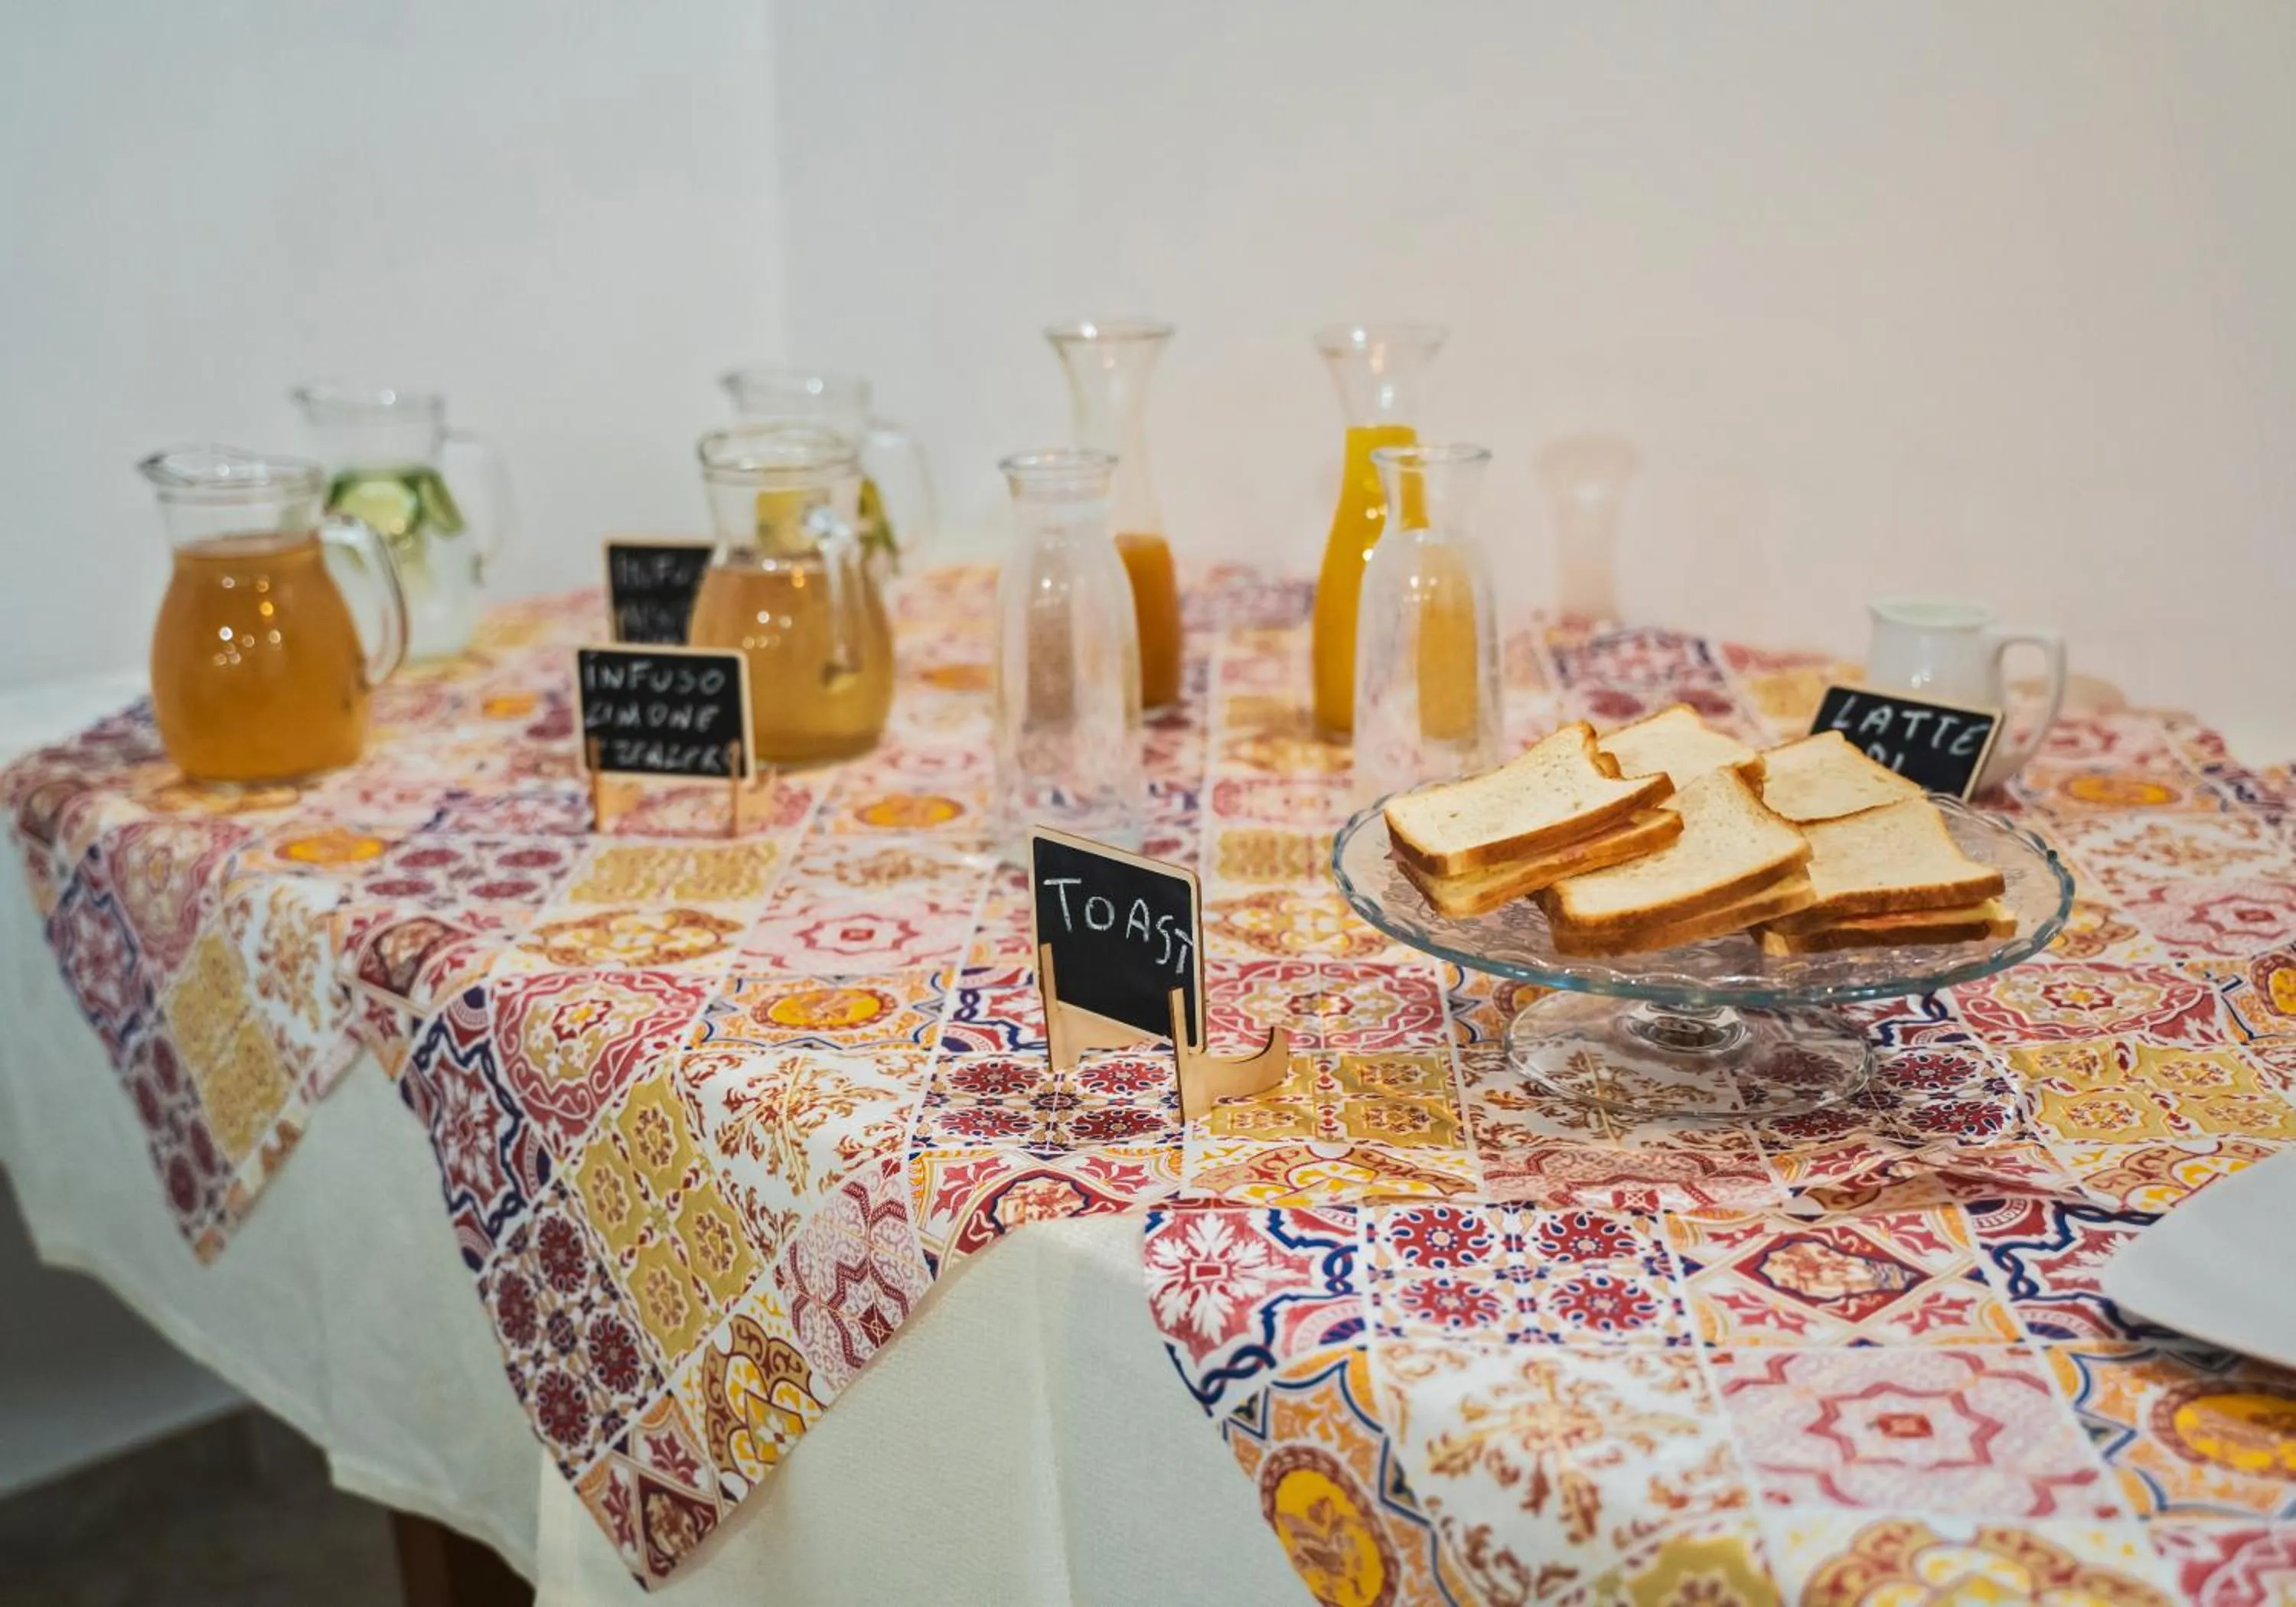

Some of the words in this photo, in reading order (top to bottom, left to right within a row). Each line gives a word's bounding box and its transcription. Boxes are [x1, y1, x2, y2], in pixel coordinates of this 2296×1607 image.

[585, 653, 726, 696] INFUSO
[1831, 694, 1990, 756] LATTE
[1042, 878, 1193, 975] TOAST
